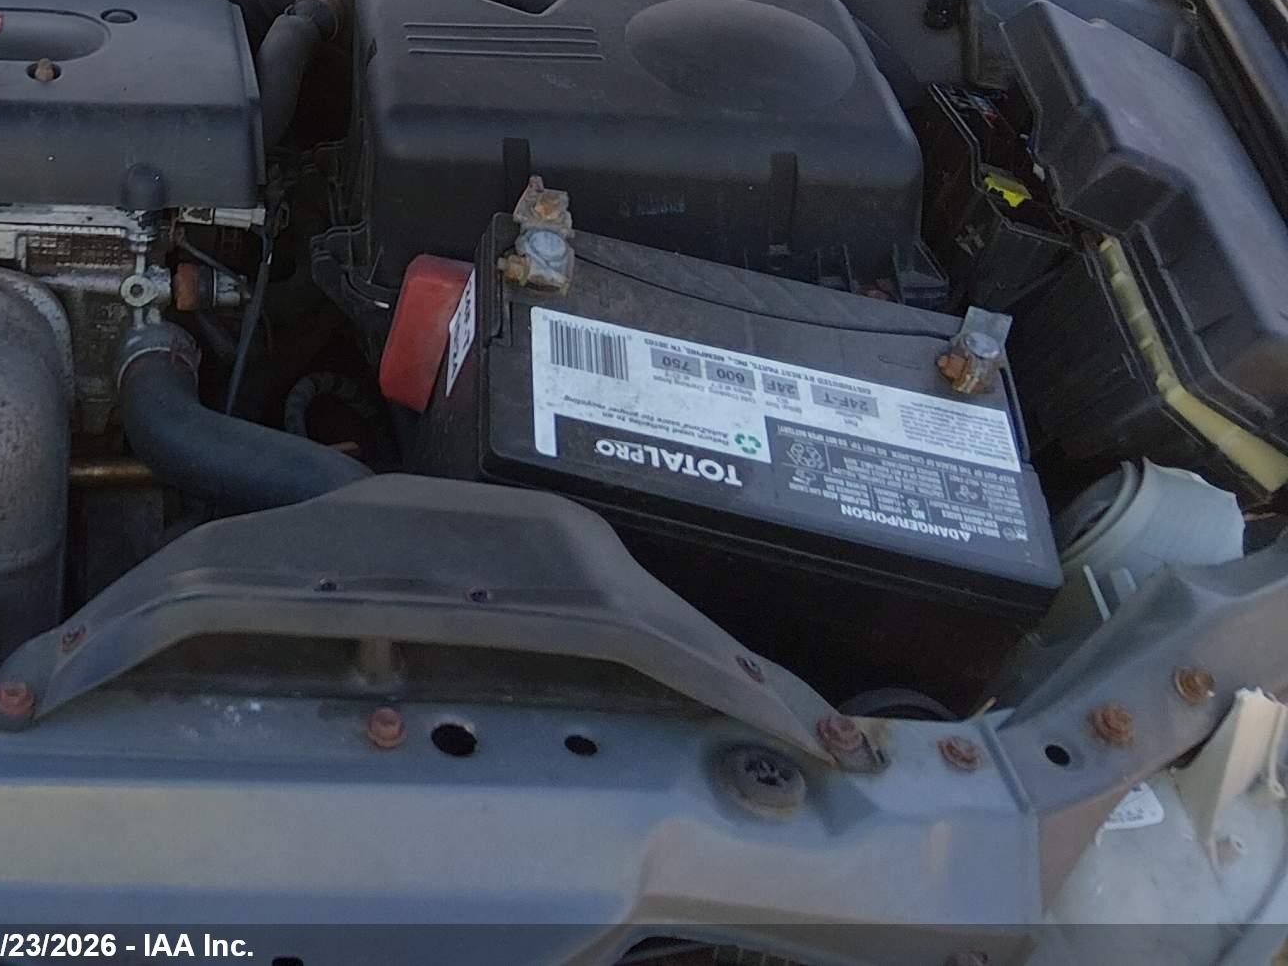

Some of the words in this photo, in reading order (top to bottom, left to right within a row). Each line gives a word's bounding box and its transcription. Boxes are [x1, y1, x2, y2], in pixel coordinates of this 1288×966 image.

[662, 355, 689, 371] 750
[716, 367, 744, 383] 600
[765, 378, 796, 395] 24F
[822, 391, 868, 413] 24F-T
[595, 439, 741, 486] TOTALPRO
[841, 504, 959, 537] DANGER/POISON
